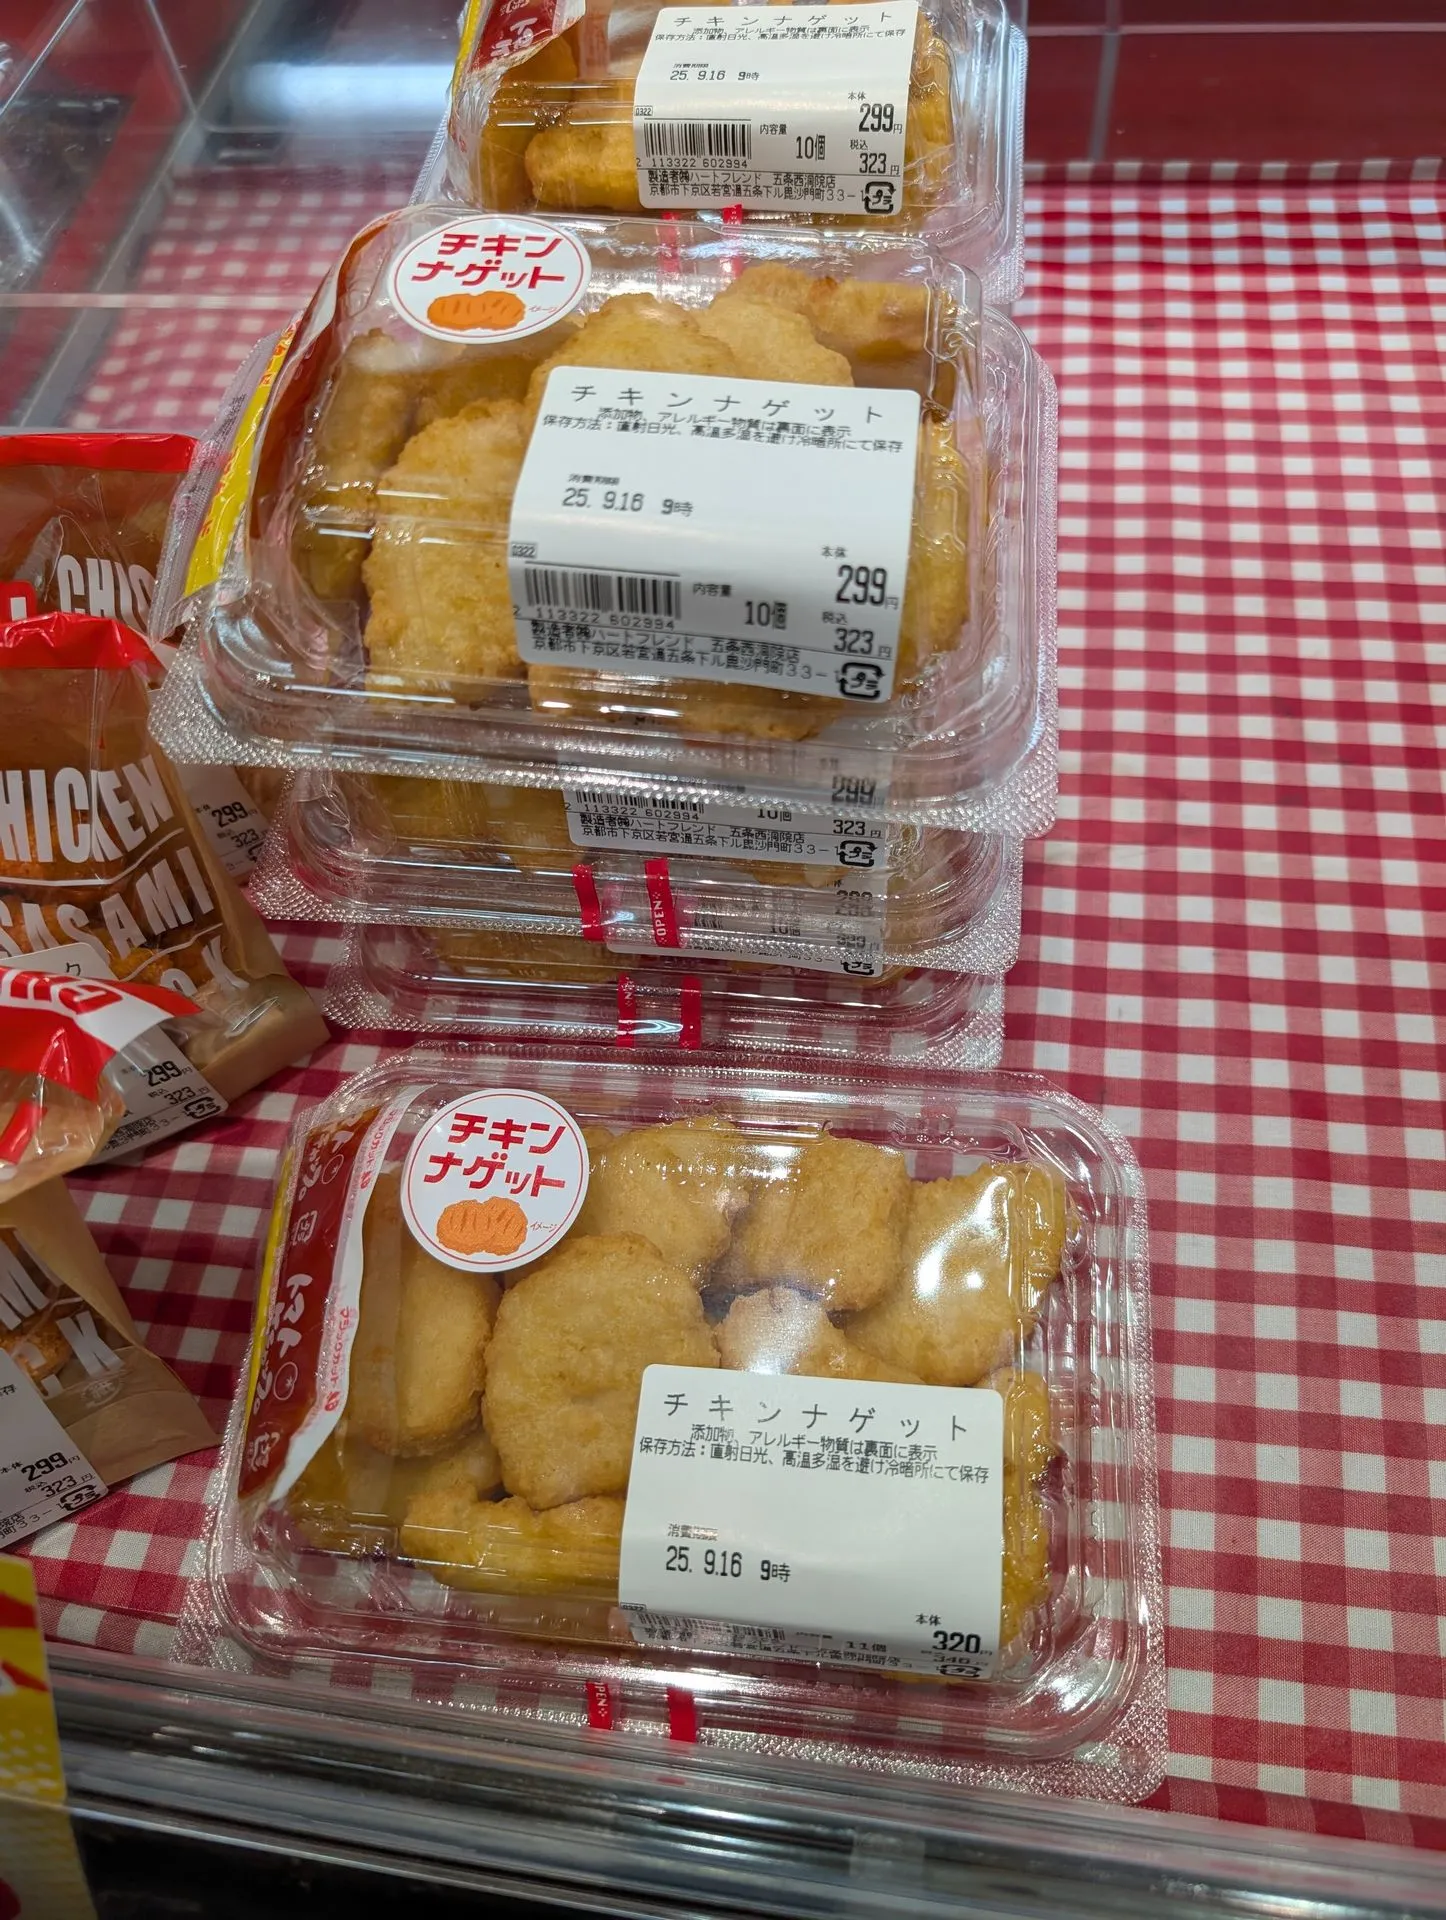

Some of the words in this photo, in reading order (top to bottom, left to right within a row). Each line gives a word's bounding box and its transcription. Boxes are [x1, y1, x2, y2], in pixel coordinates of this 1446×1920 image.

[848, 91, 866, 101] 本体
[635, 107, 653, 116] 0322
[759, 123, 788, 135] 内容量
[795, 134, 826, 161] 10個
[850, 139, 868, 151] 税込
[437, 233, 563, 258] チキン
[411, 259, 565, 289] ナゲット
[821, 545, 847, 559] 本体
[692, 582, 732, 598] 内容量
[743, 600, 788, 630] 10個
[821, 611, 848, 625] 税込
[652, 900, 668, 937] OPEN
[447, 1112, 567, 1155] チキン
[423, 1151, 566, 1198] ナゲット
[276, 1273, 313, 1358] トマト
[663, 1393, 967, 1441] チキンナゲット
[760, 1559, 792, 1582] 9時
[915, 1613, 942, 1626] 本体
